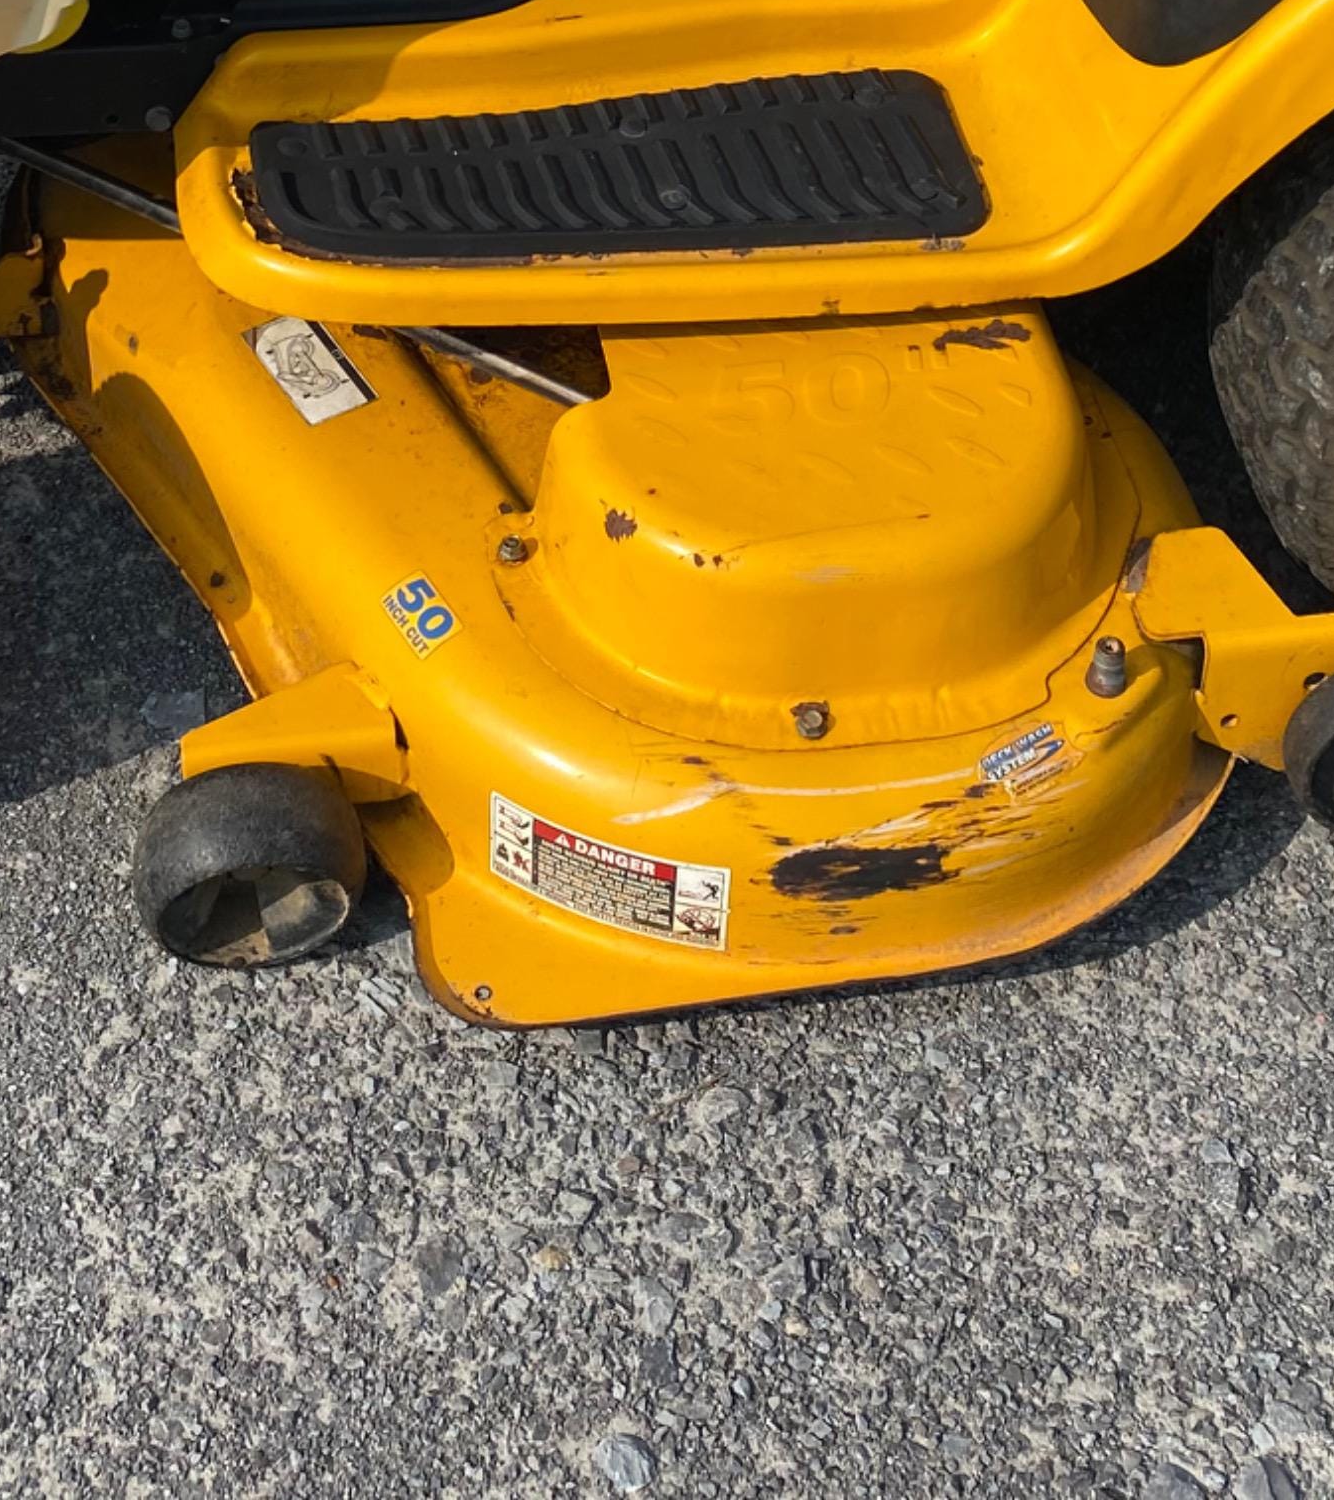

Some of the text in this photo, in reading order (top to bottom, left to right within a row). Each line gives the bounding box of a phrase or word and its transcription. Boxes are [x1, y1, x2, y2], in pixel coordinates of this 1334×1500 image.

[382, 594, 430, 654] INCH CUT
[396, 578, 454, 640] 50
[574, 841, 656, 876] DANGER
